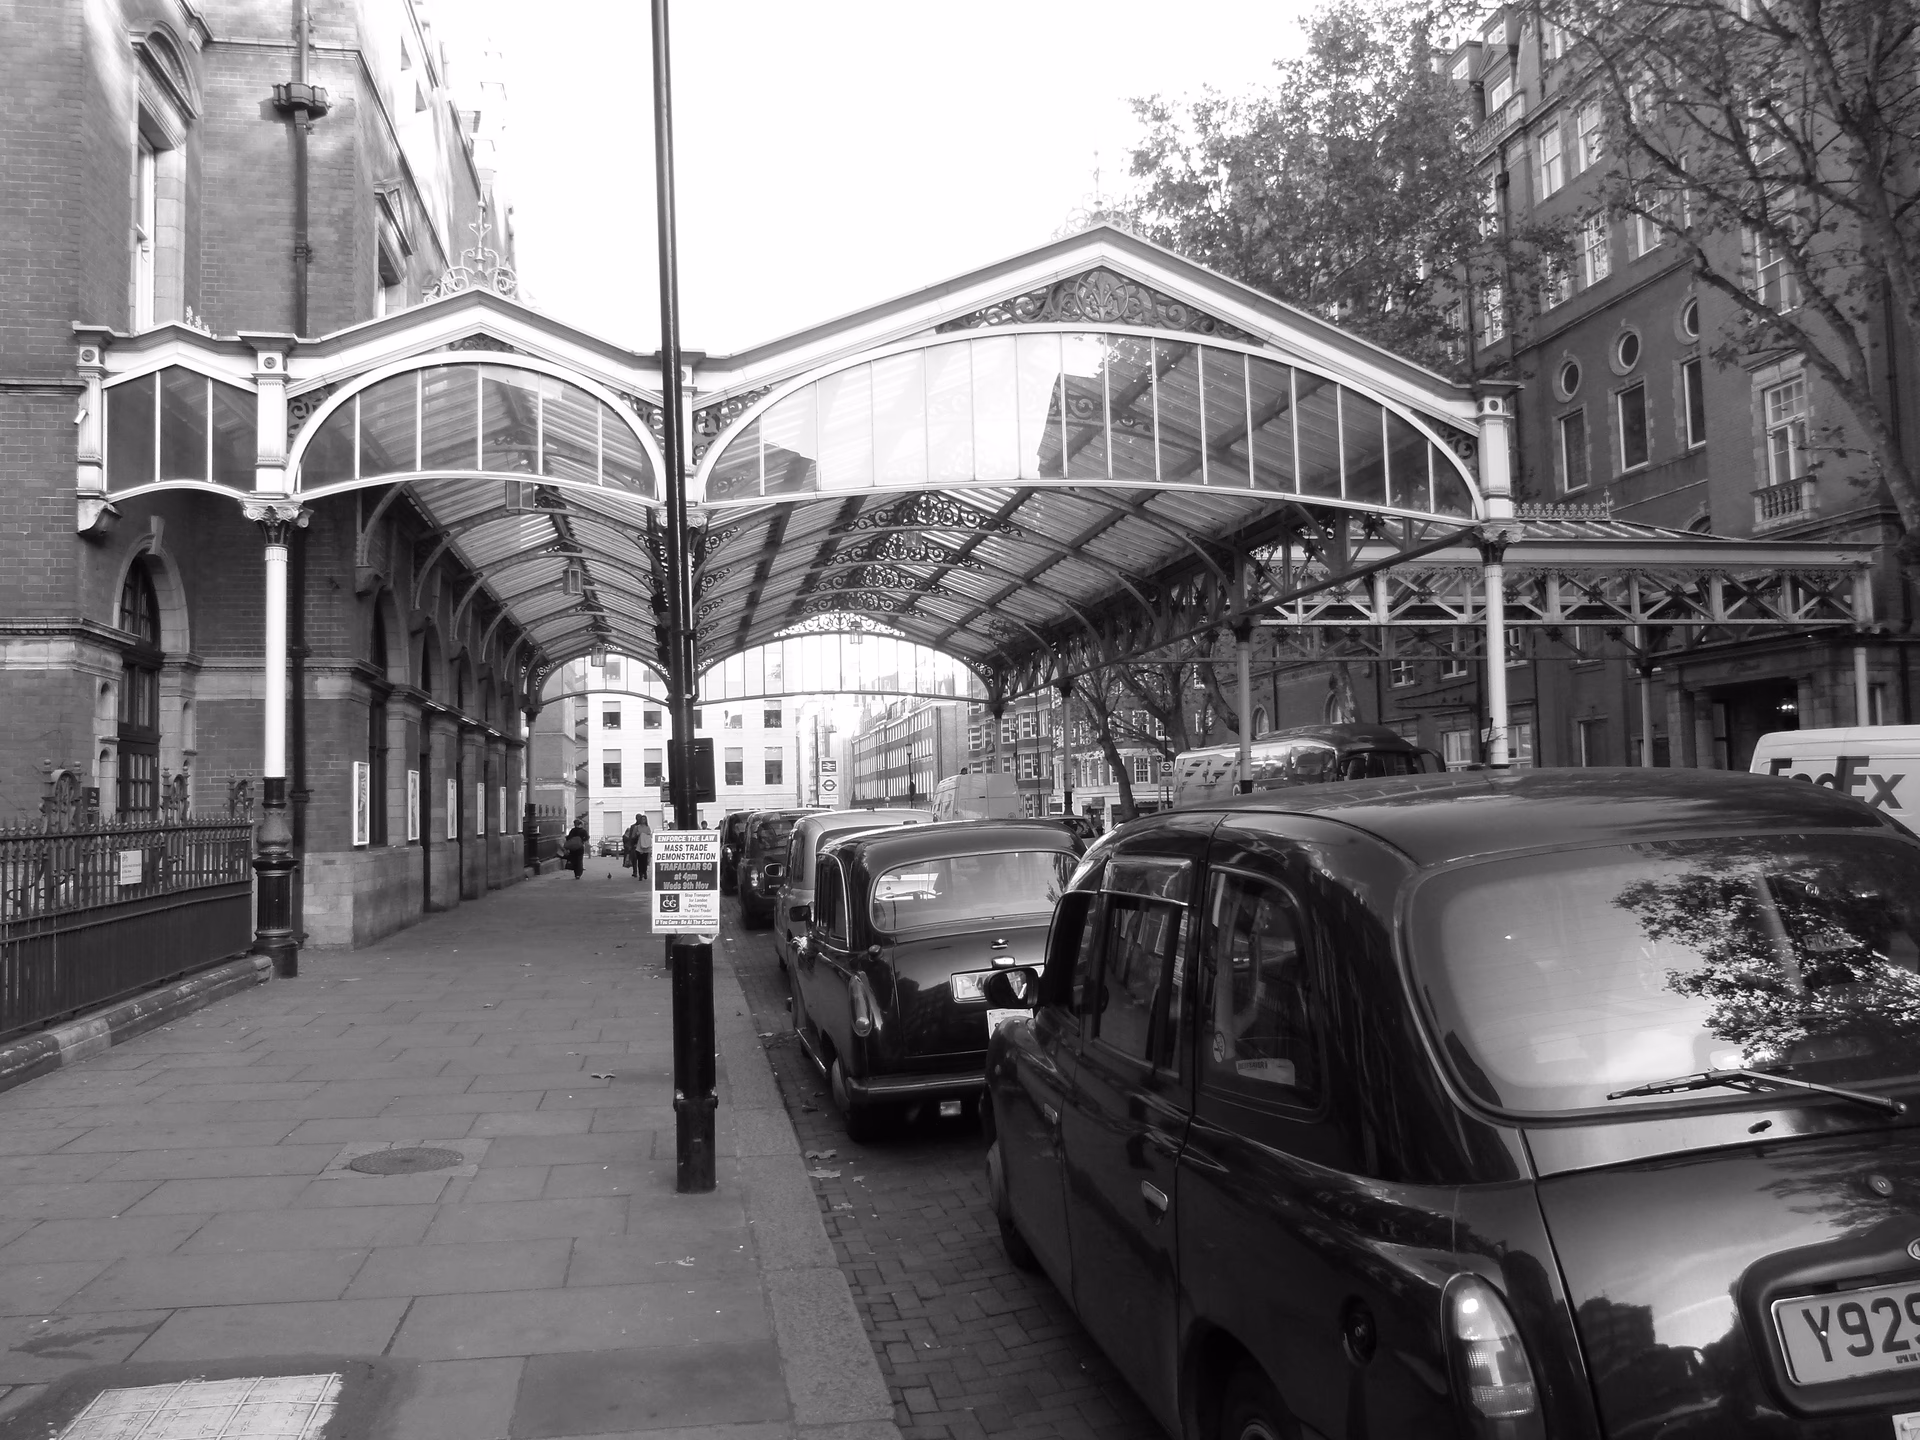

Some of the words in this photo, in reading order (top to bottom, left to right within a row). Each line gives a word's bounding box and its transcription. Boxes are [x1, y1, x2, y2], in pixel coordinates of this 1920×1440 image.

[660, 863, 701, 871] TRAFALGAR
[702, 863, 712, 871] SQ
[674, 872, 682, 880] at
[682, 872, 698, 881] 4pm
[663, 881, 681, 889] Weds
[682, 881, 694, 889] 9th
[695, 881, 709, 889] Nov
